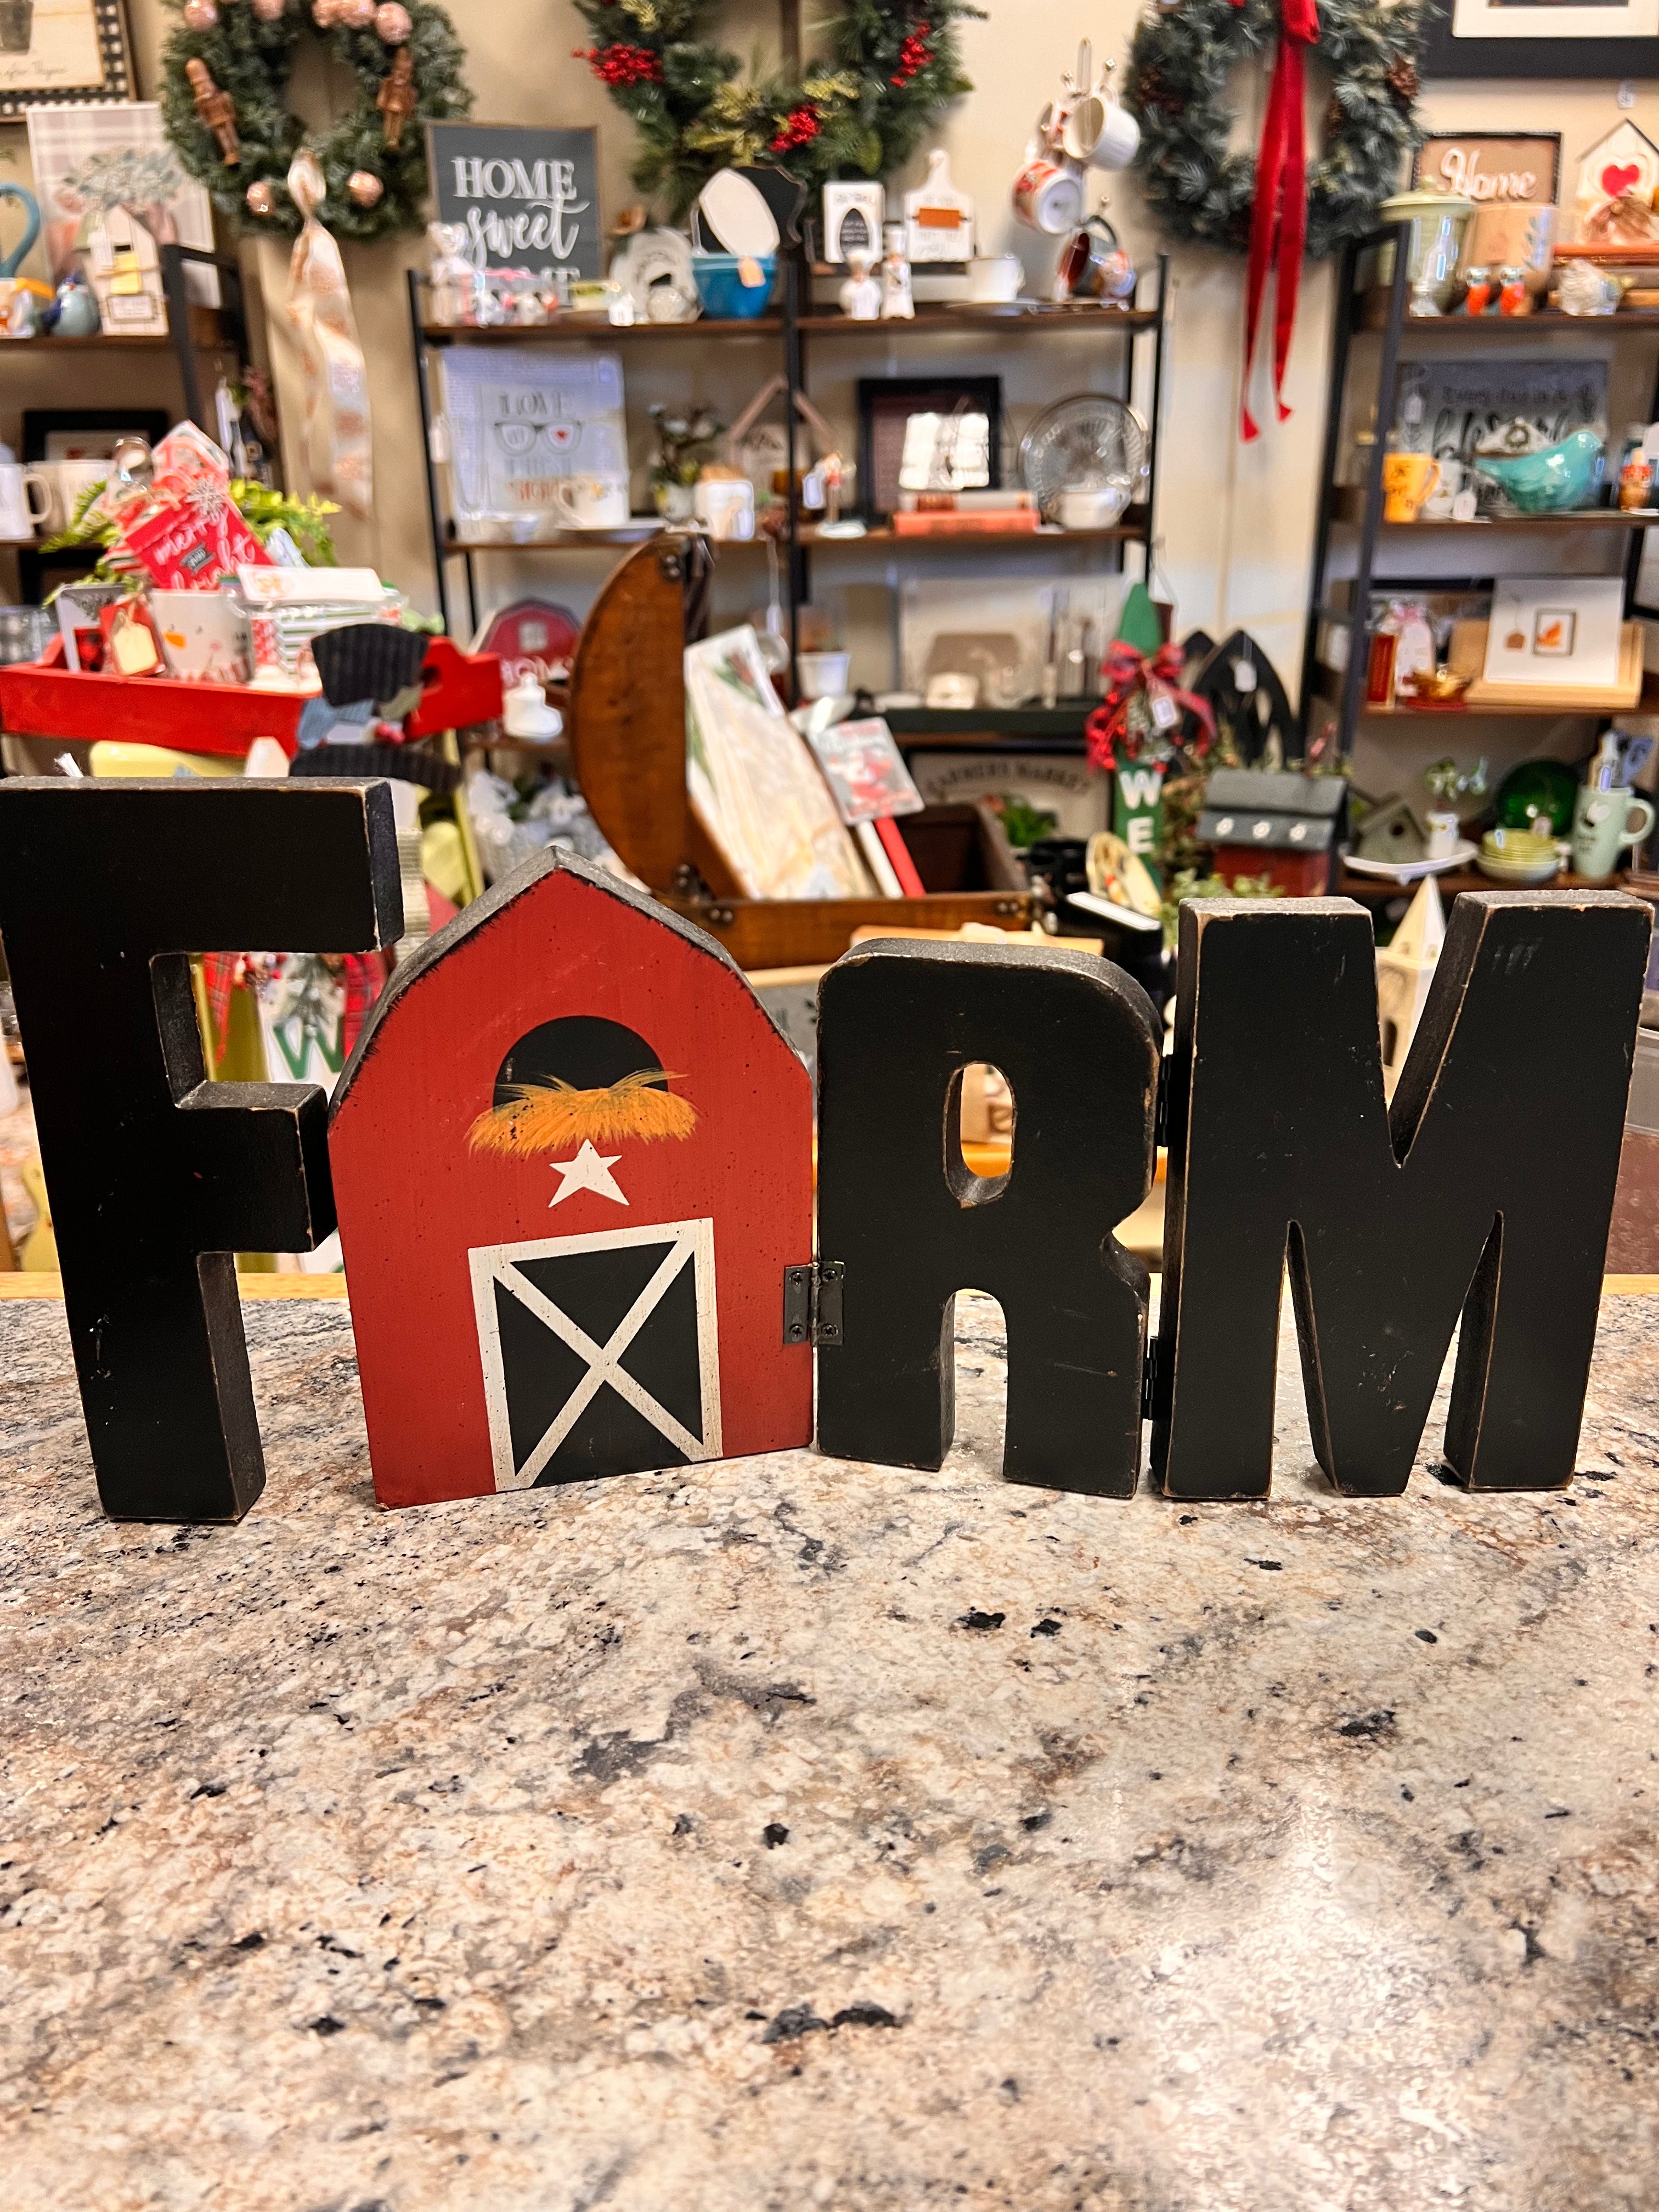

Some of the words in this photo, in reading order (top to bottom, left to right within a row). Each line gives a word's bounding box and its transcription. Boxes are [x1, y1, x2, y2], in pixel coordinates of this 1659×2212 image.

[451, 156, 577, 199] HOME
[1438, 147, 1536, 200] Home
[466, 196, 590, 272] sweet
